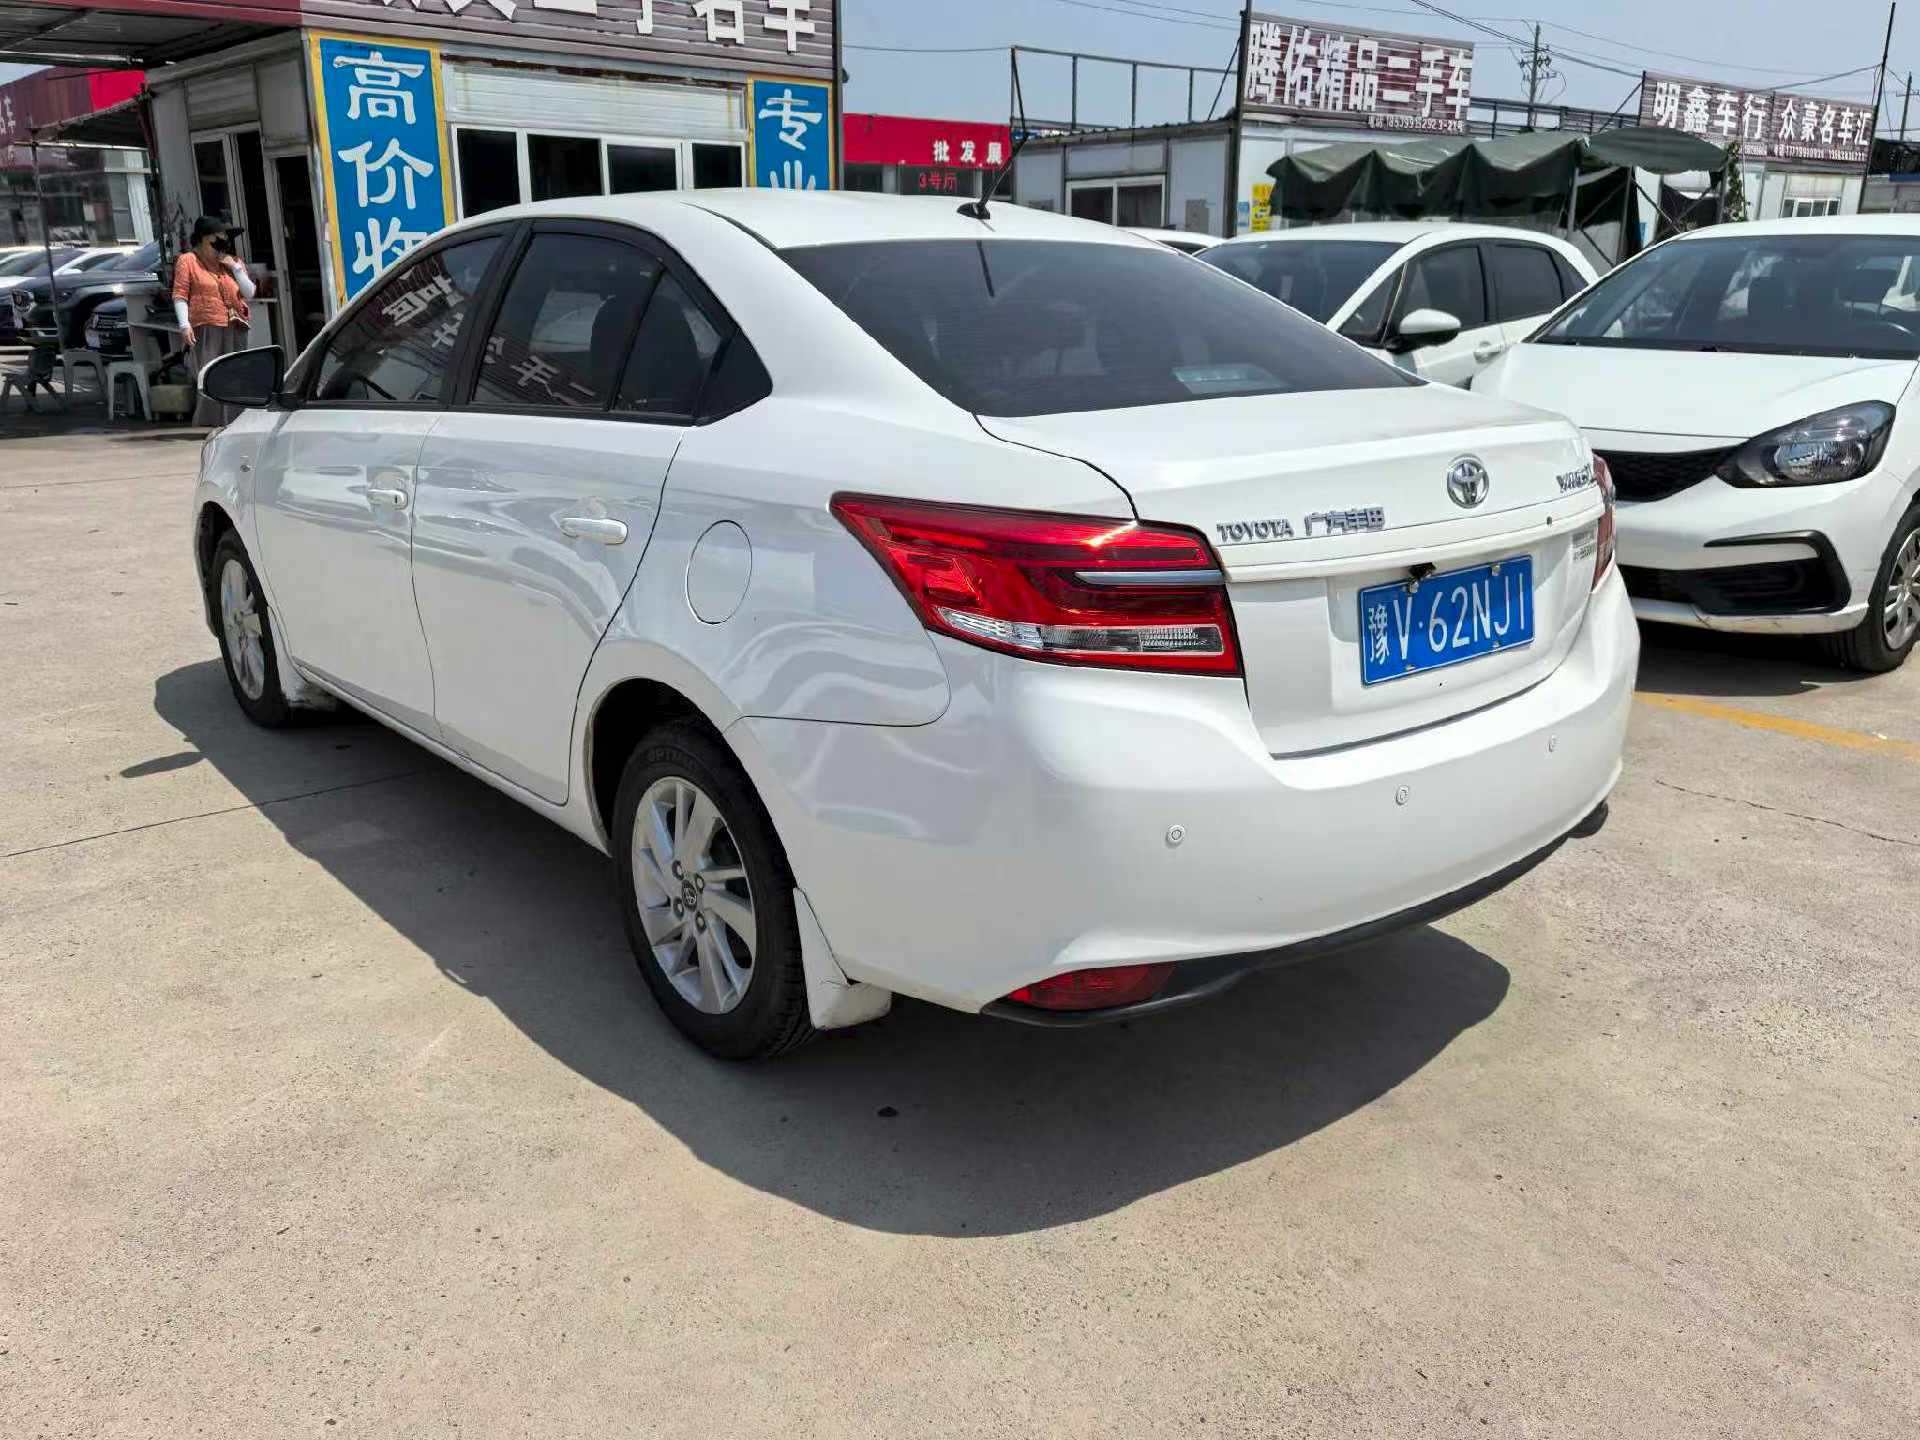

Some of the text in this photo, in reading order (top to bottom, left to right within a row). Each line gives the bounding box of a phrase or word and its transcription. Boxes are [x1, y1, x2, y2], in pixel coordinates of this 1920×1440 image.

[1652, 81, 1766, 140] 明鑫车行
[1778, 98, 1872, 145] 众豪名车汇
[1216, 519, 1295, 542] TOYOTA
